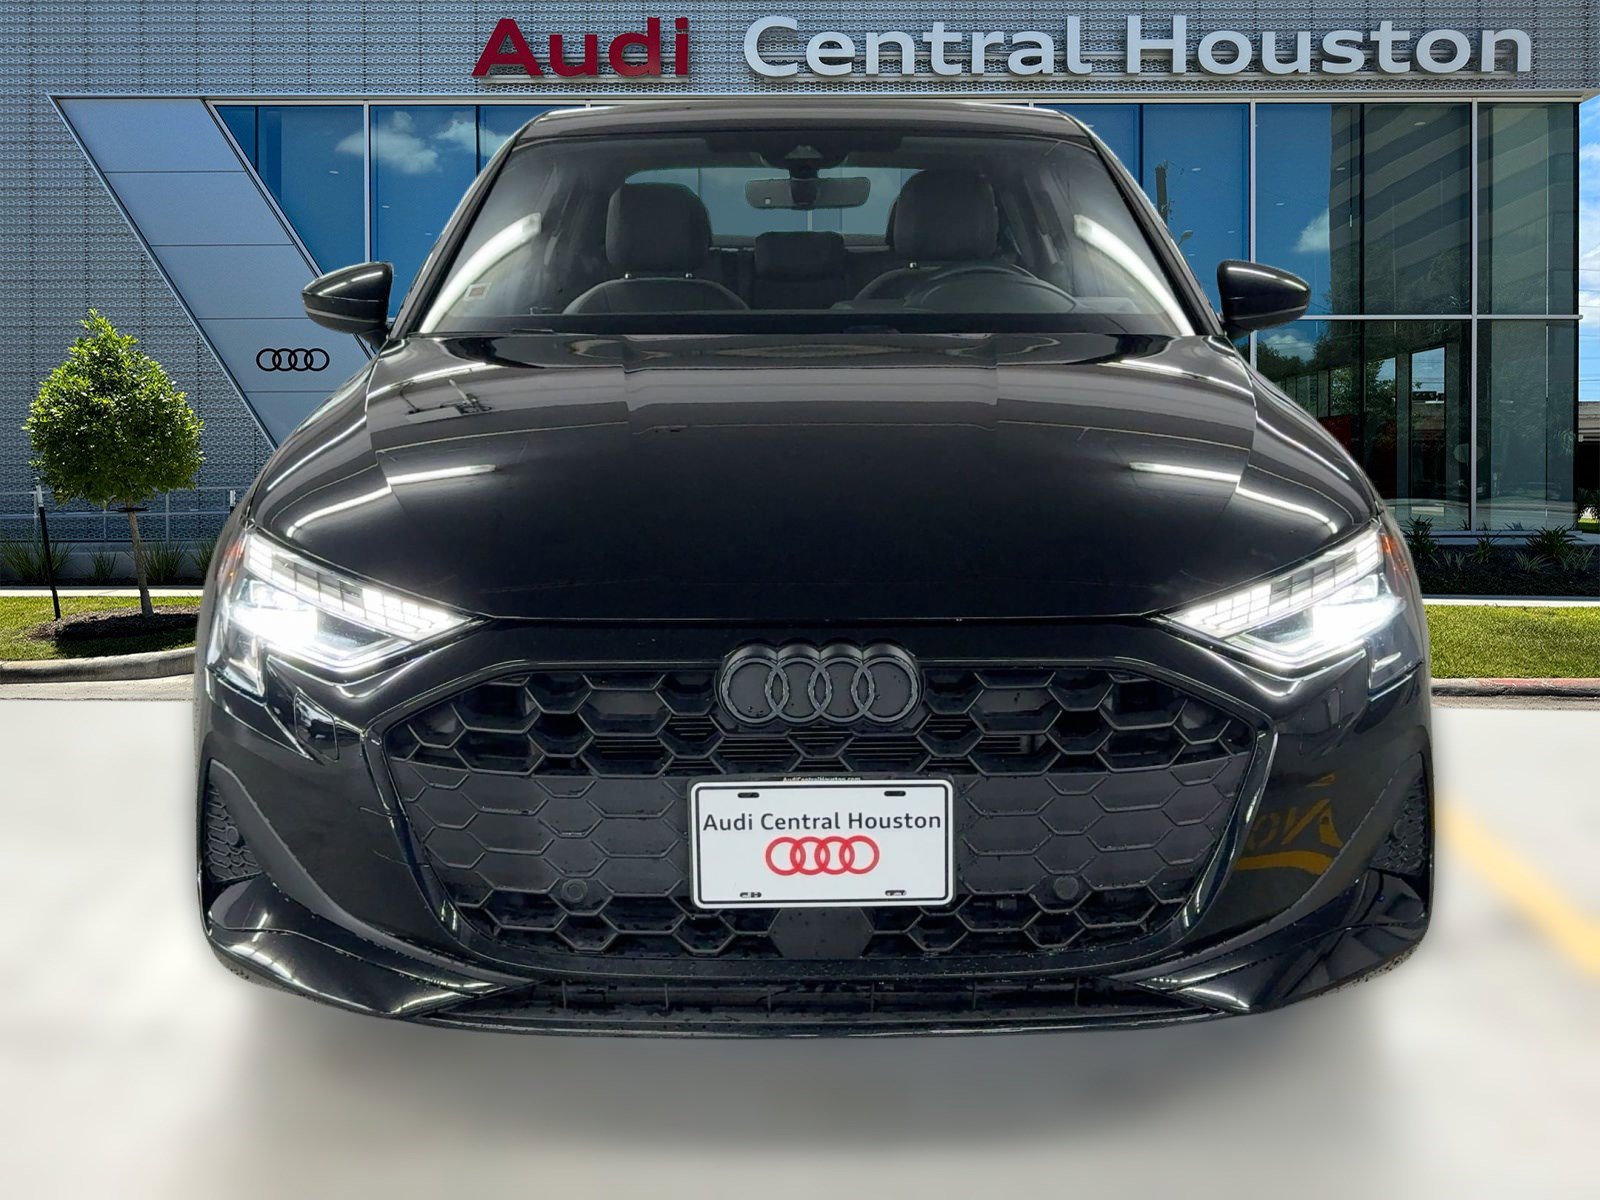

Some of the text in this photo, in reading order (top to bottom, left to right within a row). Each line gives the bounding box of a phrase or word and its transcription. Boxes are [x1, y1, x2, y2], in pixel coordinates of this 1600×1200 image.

[471, 15, 1532, 78] Audi Central Houston
[703, 812, 941, 831] Audi Central Houston
